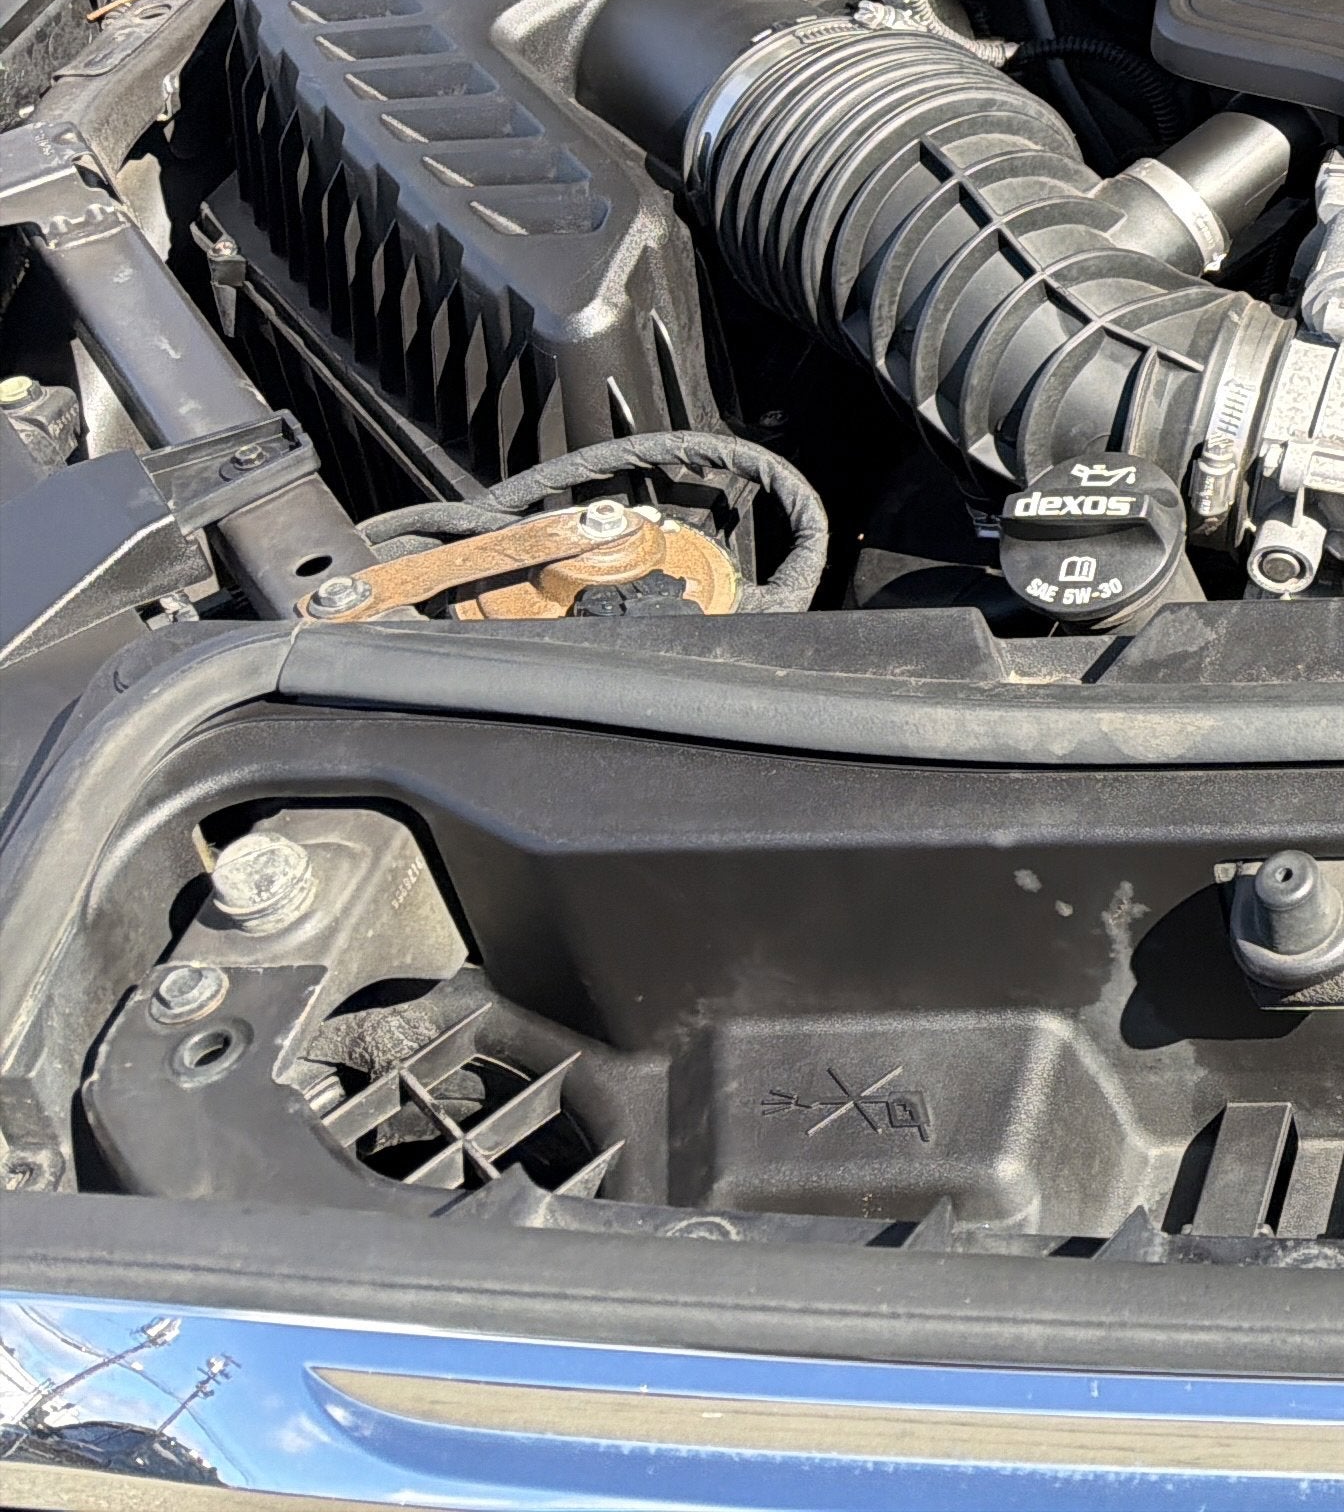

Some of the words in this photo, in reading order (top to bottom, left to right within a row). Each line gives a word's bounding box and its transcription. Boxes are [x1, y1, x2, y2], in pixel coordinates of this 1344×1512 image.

[1014, 491, 1134, 517] dexos
[1025, 577, 1059, 603] SAE
[1062, 577, 1123, 605] 5W-30
